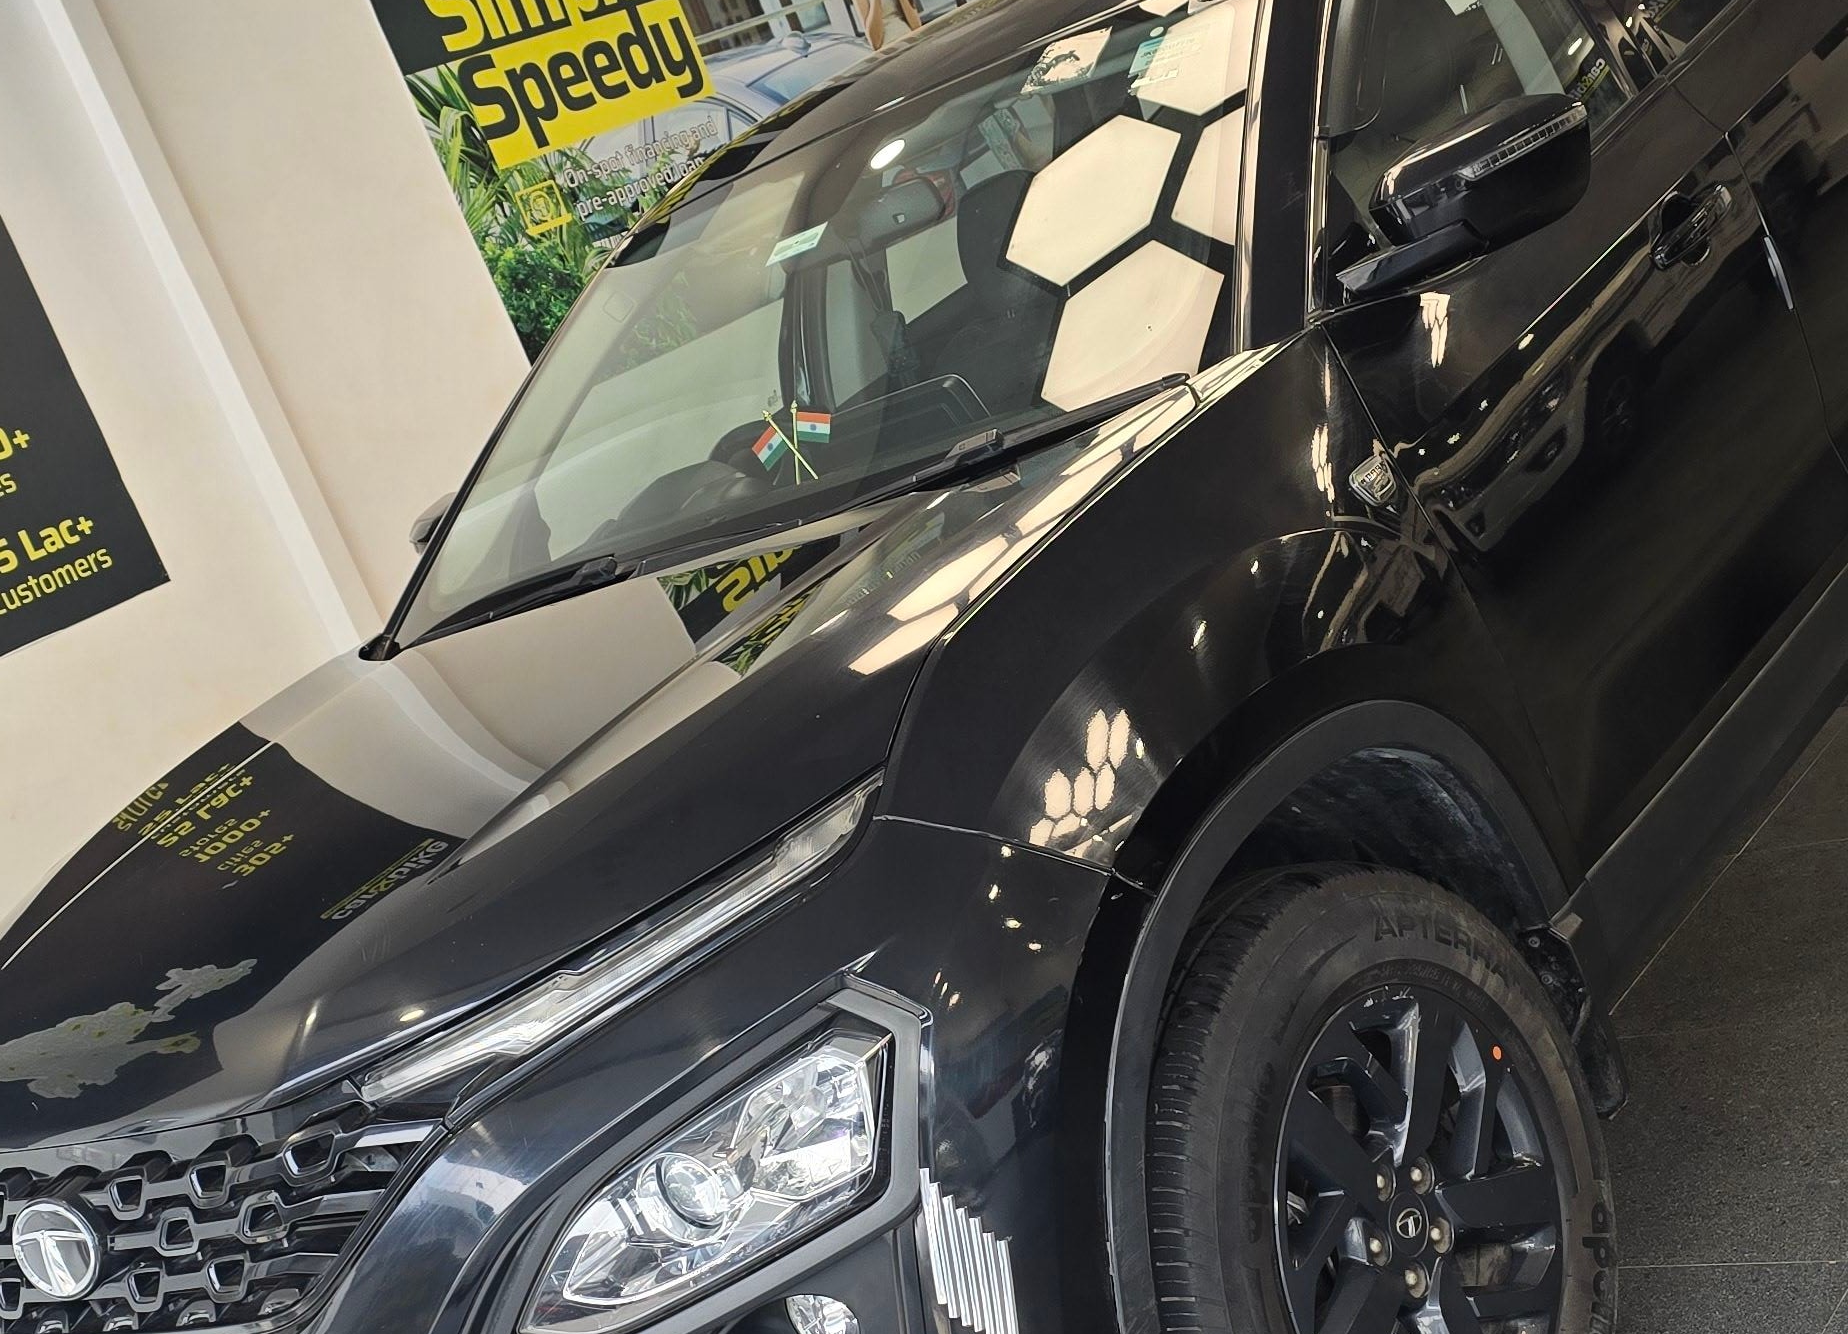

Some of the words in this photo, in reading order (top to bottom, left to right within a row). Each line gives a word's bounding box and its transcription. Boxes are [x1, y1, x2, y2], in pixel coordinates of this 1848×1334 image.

[458, 9, 704, 149] Speedy
[564, 153, 624, 189] On-spot
[624, 129, 692, 167] financing
[692, 116, 718, 140] and
[573, 160, 674, 220] pre-approved
[18, 516, 93, 561] Lac+
